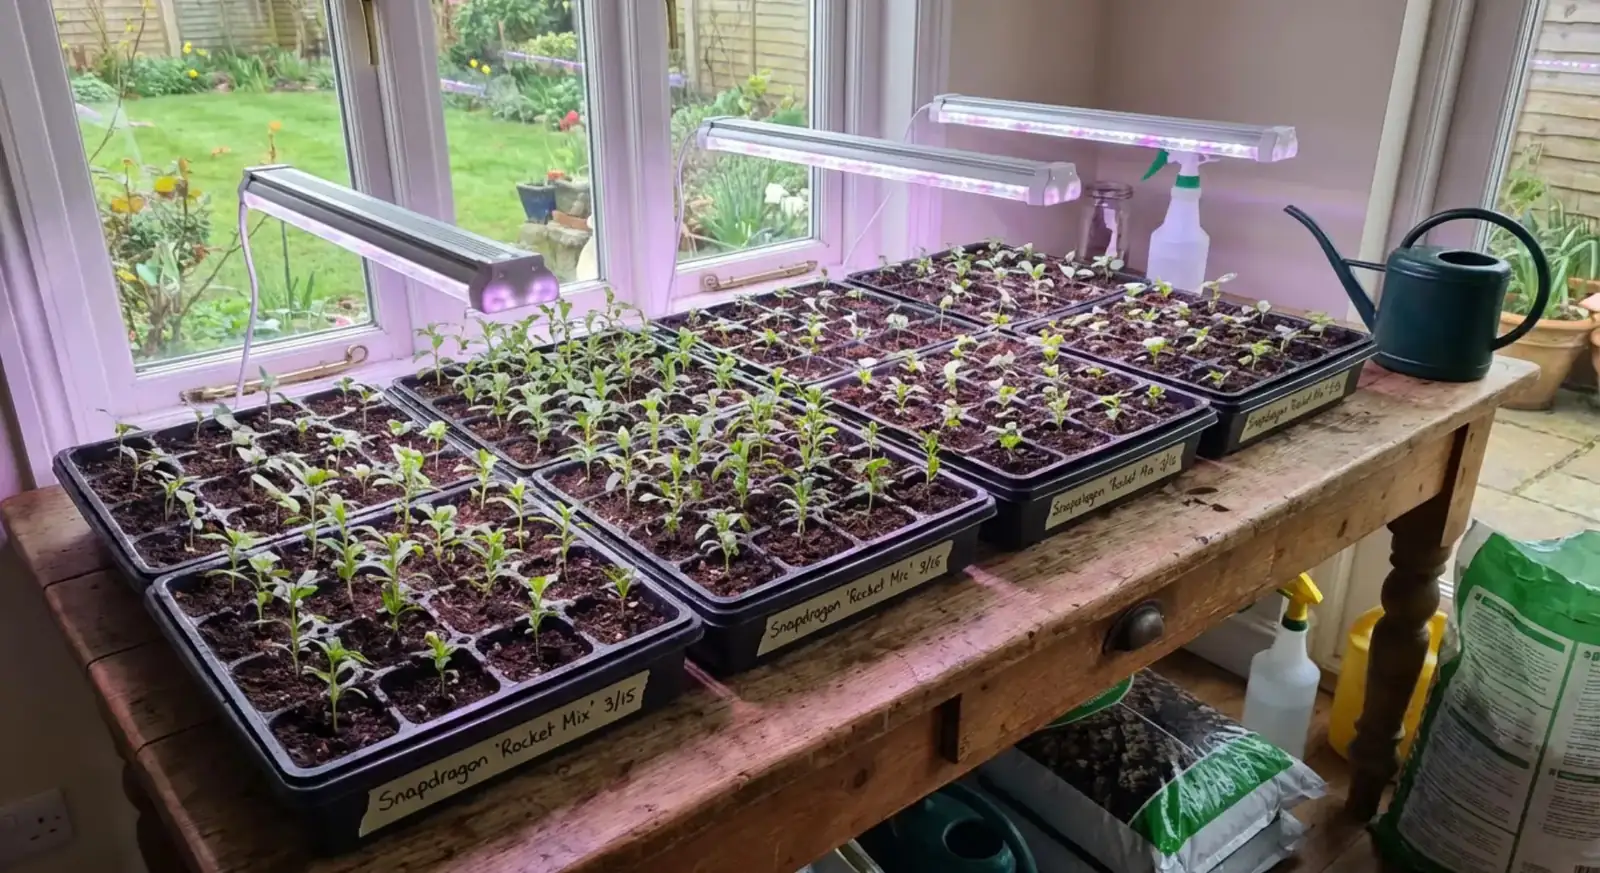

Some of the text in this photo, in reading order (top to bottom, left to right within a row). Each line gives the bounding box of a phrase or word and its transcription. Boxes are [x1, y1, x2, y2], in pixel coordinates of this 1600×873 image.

[770, 600, 841, 638] Snapdragon
[379, 687, 636, 811] Snapdragon 'Rocket Mix' 3/15
